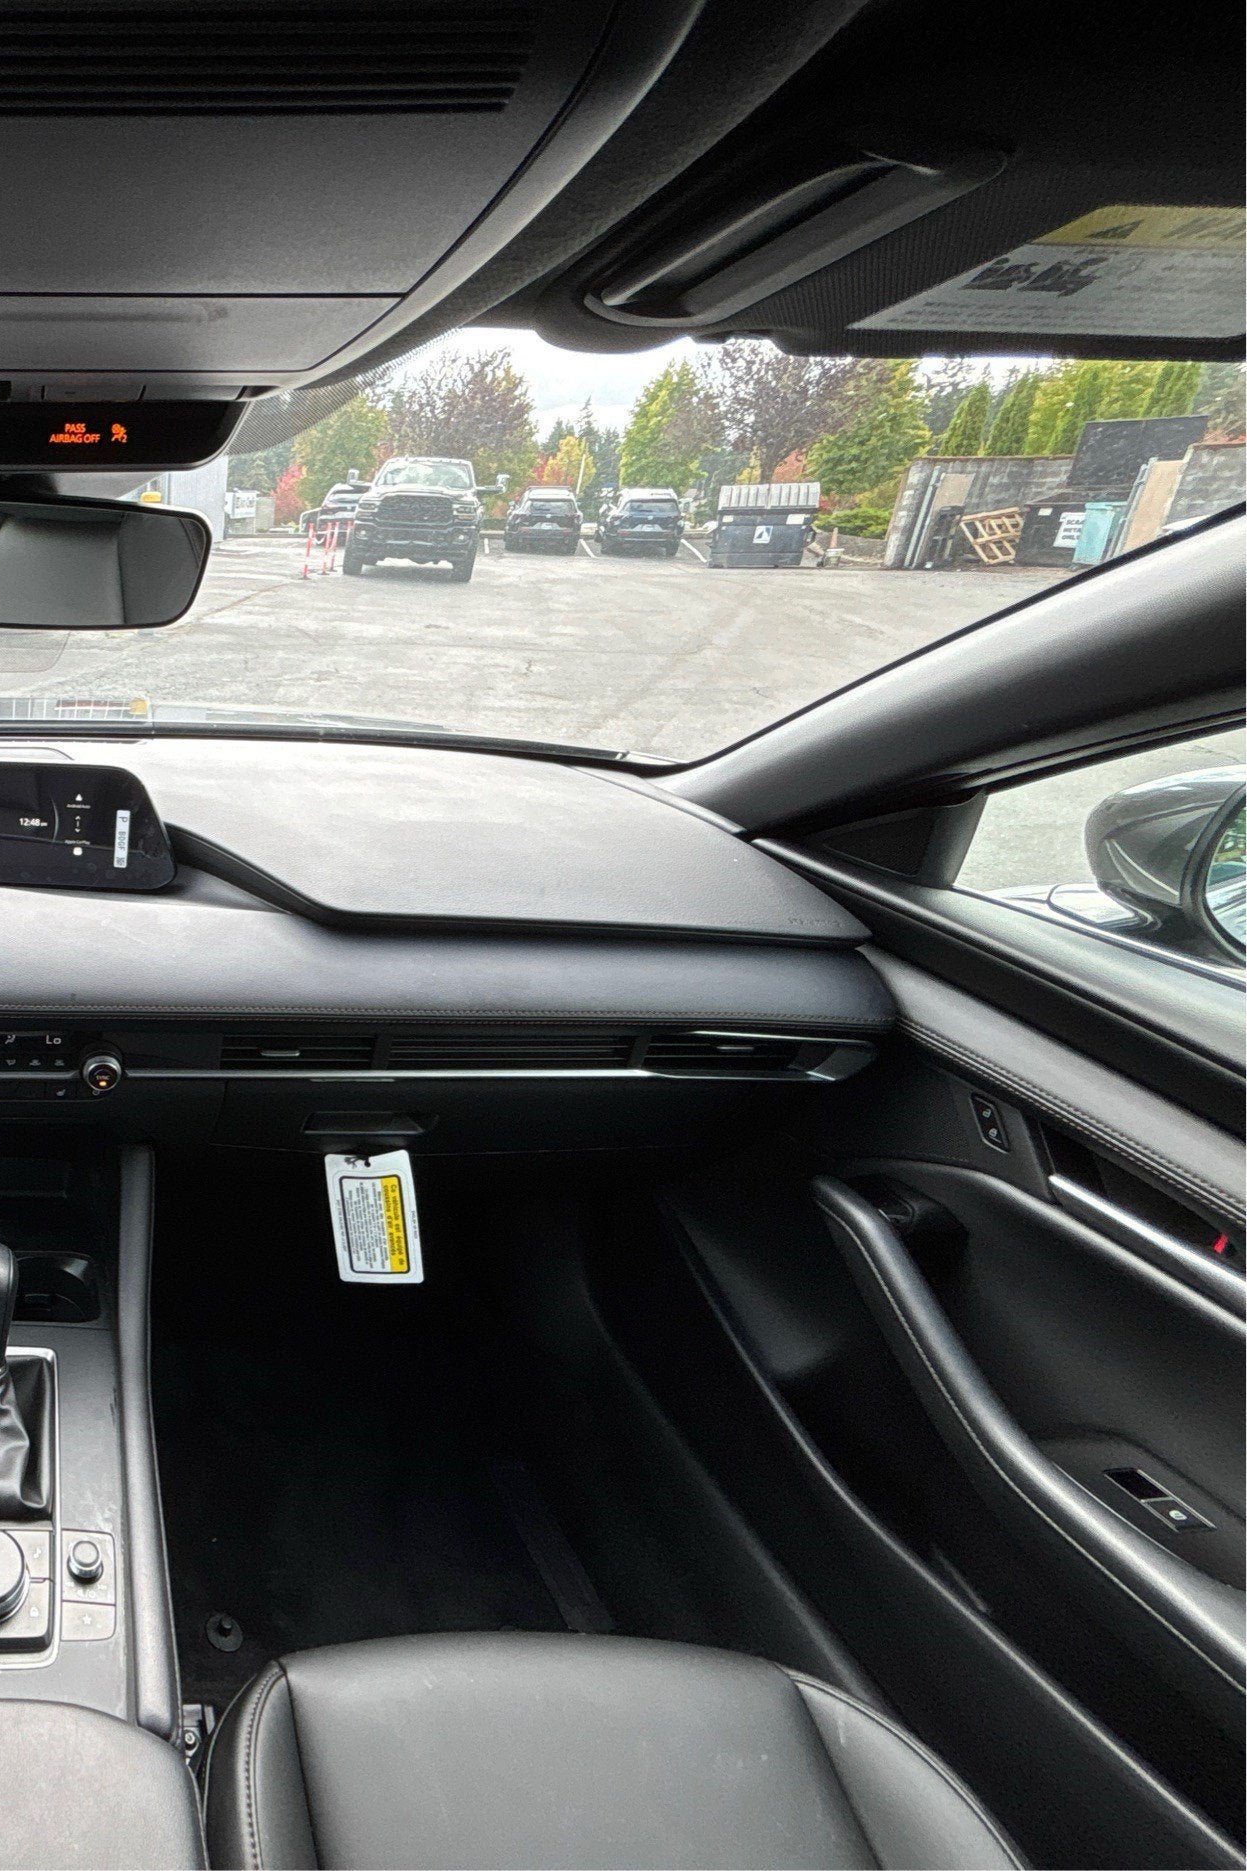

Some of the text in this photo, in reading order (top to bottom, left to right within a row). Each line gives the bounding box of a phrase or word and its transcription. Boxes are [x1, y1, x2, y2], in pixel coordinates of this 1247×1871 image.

[64, 423, 87, 433] PASS
[49, 433, 101, 443] AIRBAG OFF
[19, 817, 40, 827] 12:48
[46, 1034, 62, 1045] Lo
